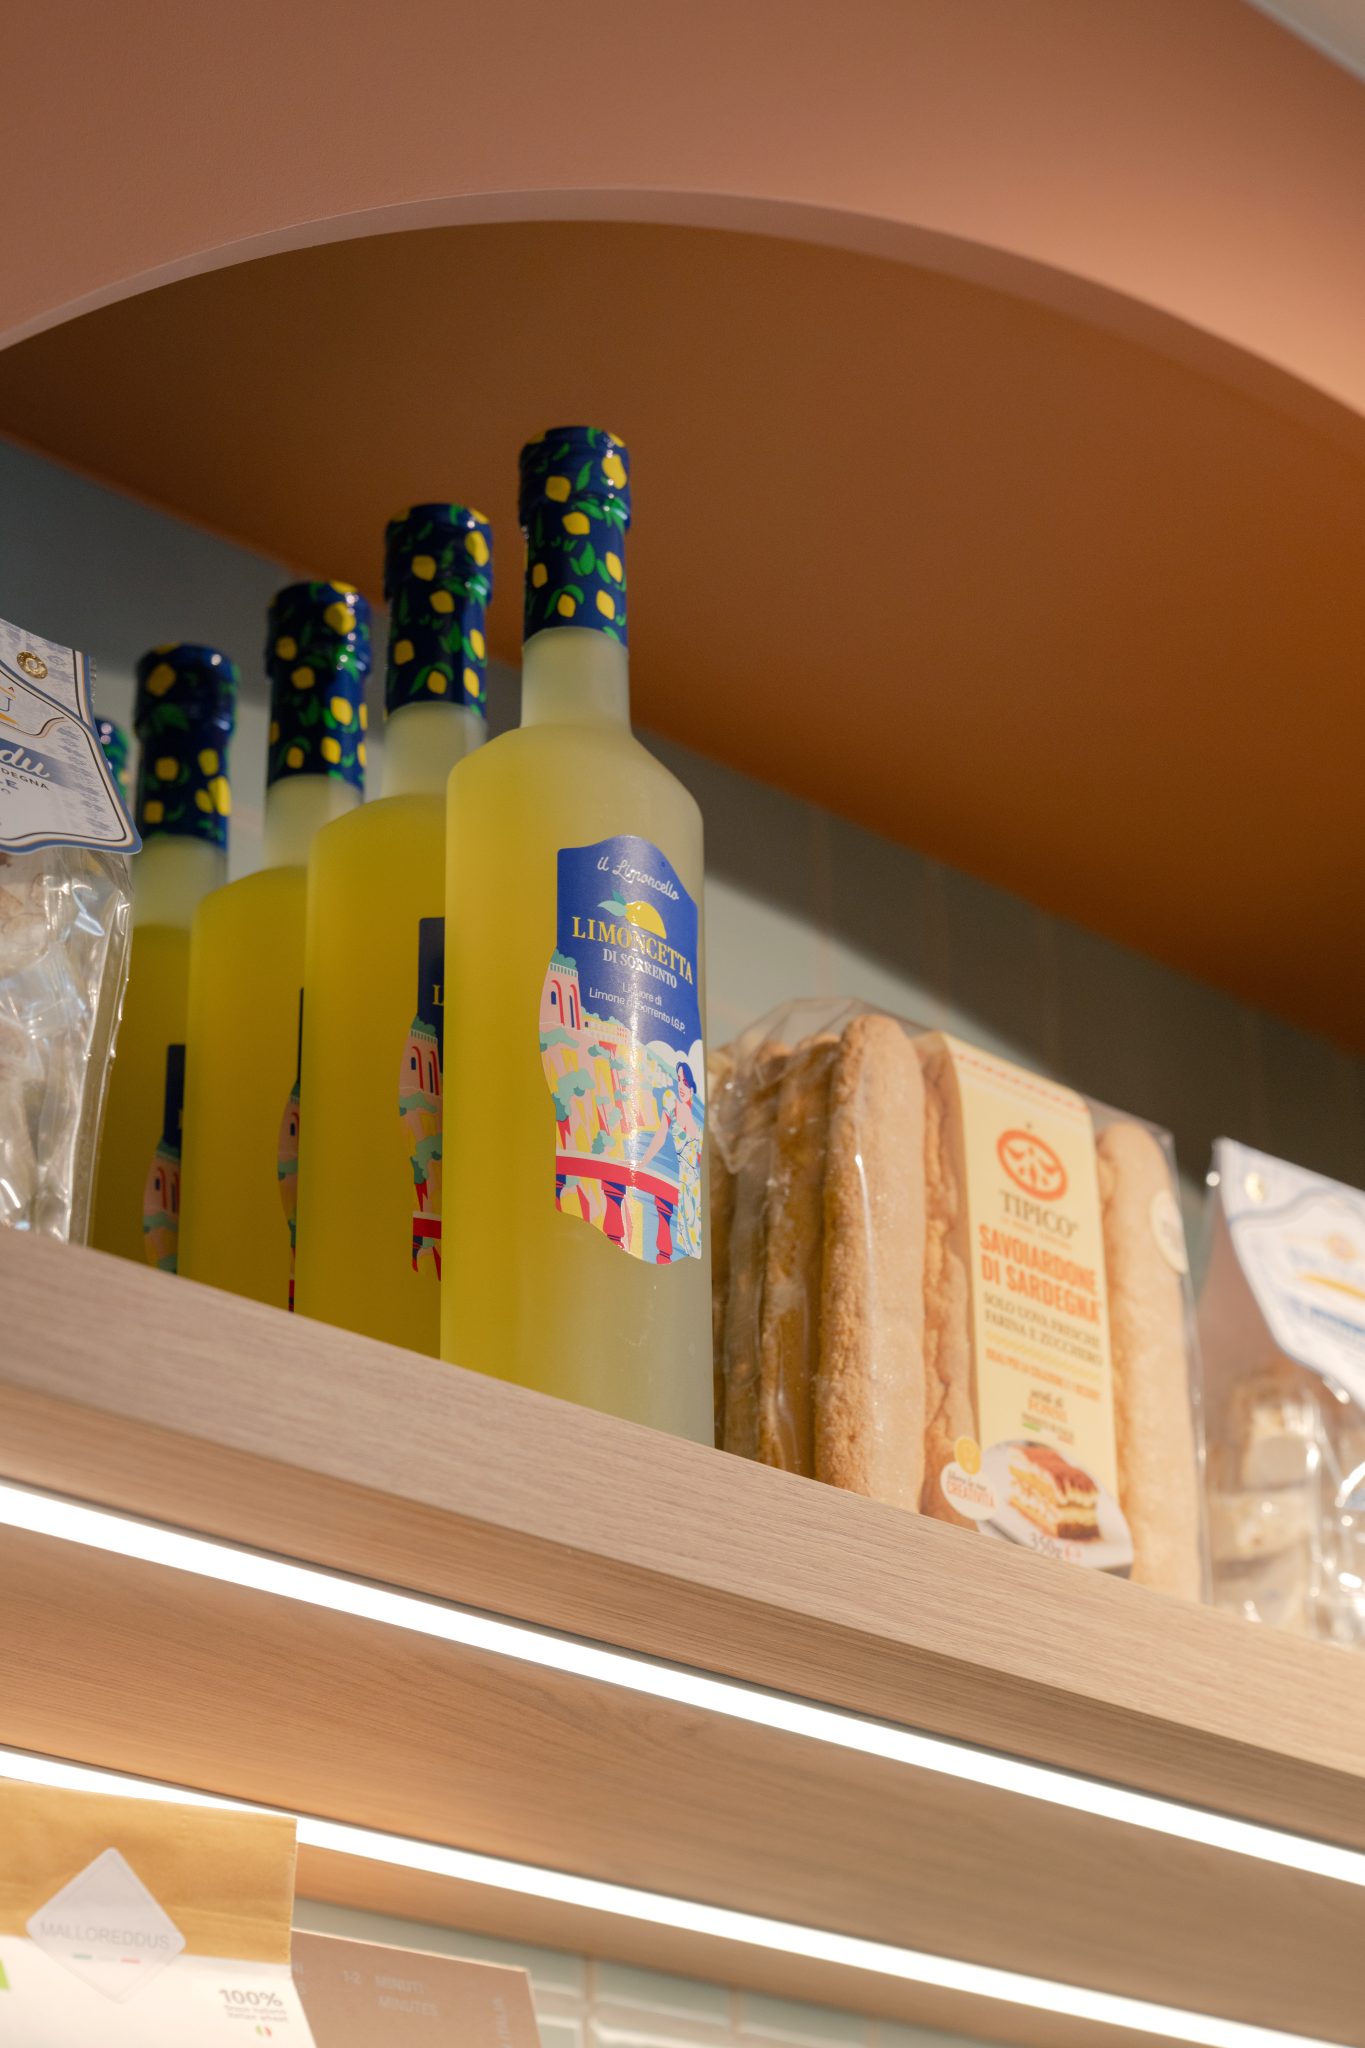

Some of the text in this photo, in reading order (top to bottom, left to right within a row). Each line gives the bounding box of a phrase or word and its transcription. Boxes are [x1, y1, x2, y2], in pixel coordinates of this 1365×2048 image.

[597, 857, 680, 900] il Limoncello
[572, 916, 693, 985] LIMONCETTA
[603, 948, 677, 989] DI SORRENTO
[589, 987, 625, 1005] Limone
[654, 996, 662, 1007] di
[979, 1223, 1098, 1297] SAVOIARDONE
[981, 1254, 1100, 1327] DI SARDEGNA
[39, 1921, 170, 1950] MALLOREDDUS
[219, 1988, 284, 2007] 100%
